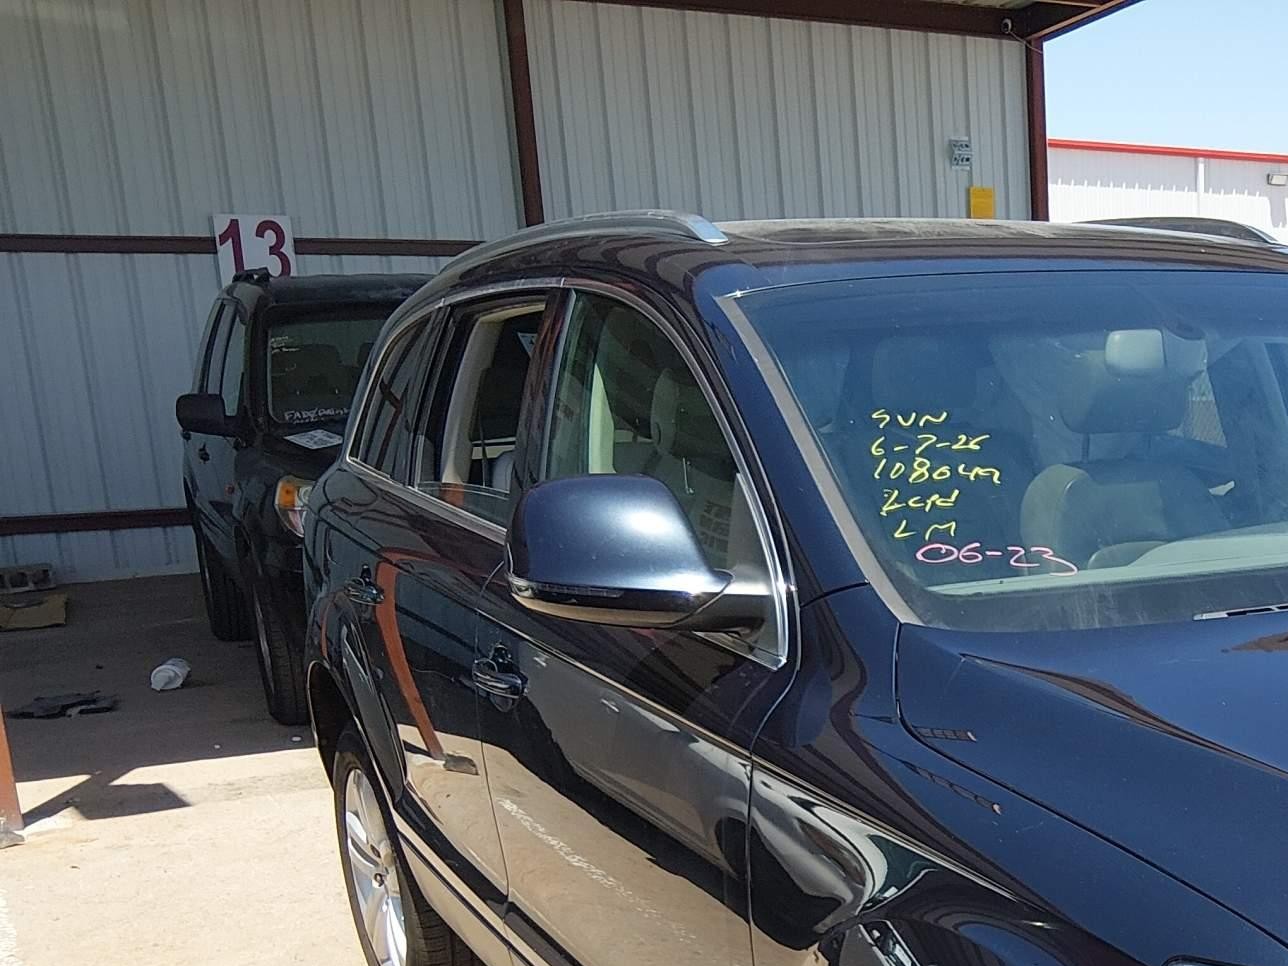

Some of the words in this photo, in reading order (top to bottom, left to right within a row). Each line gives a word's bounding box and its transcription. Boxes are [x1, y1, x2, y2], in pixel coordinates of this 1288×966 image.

[219, 218, 292, 277] 13
[870, 433, 991, 456] 6-7-26
[915, 542, 1079, 577] 06-23
